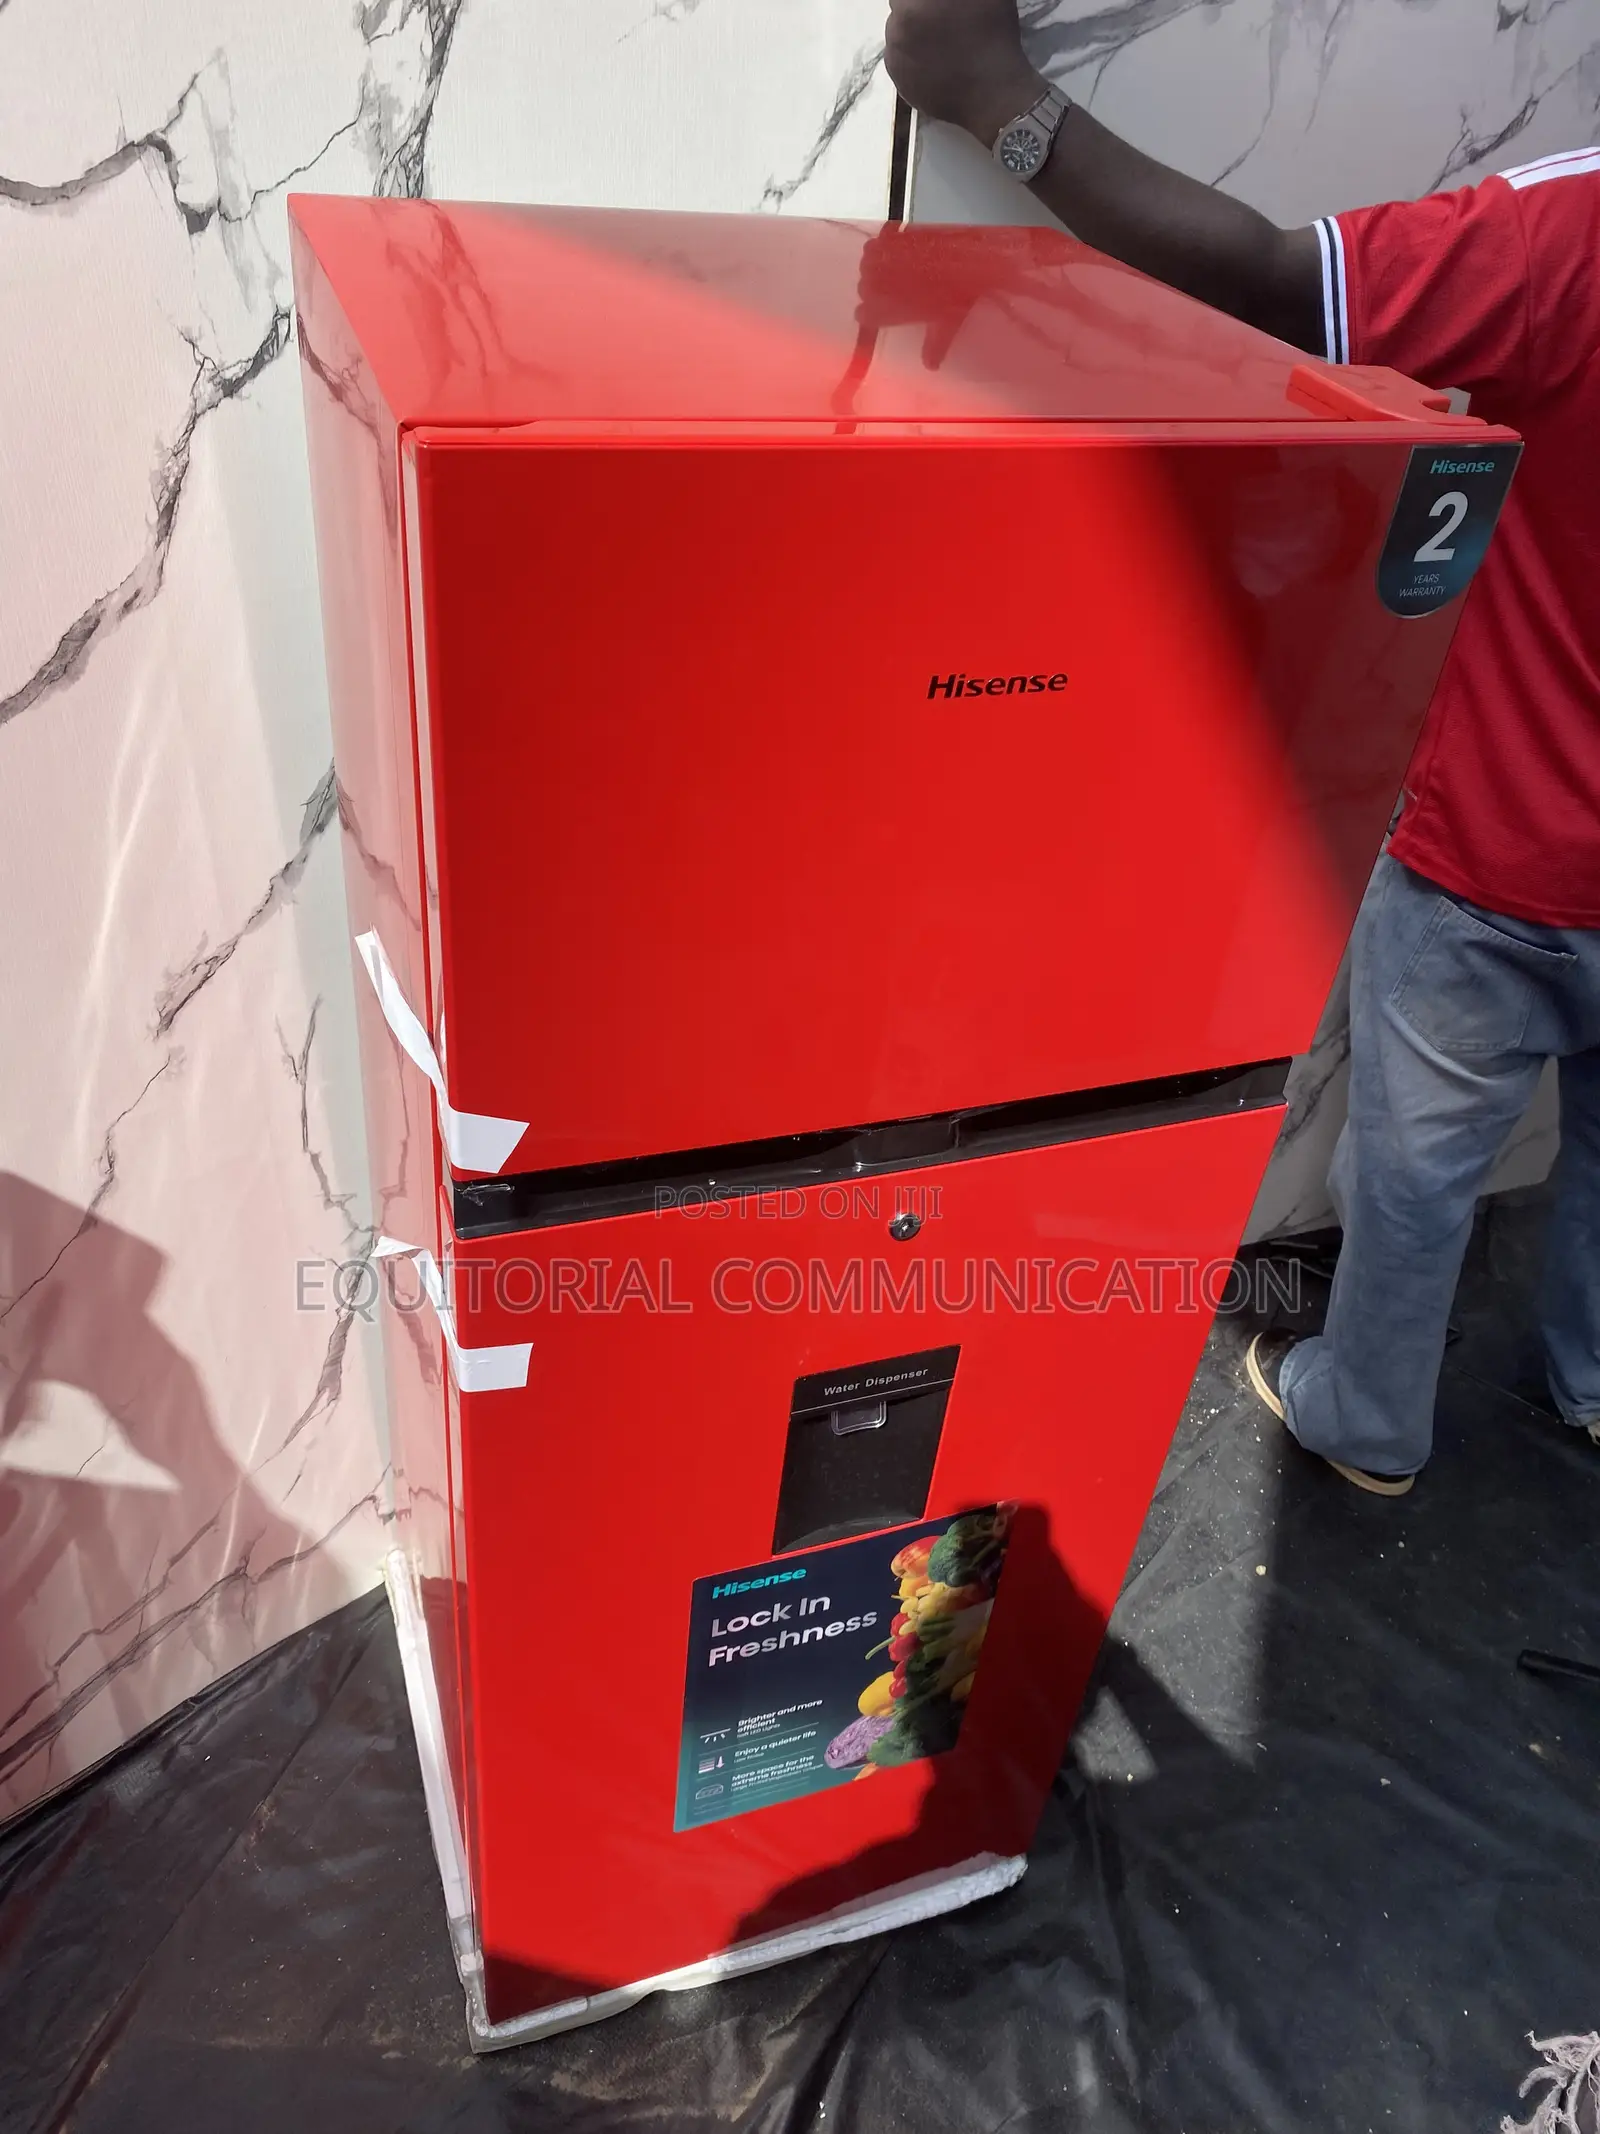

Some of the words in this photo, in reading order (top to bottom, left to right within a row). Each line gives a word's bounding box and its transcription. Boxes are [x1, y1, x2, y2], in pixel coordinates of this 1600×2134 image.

[1429, 459, 1495, 474] Hisense
[1413, 491, 1468, 562] 2
[1399, 586, 1446, 597] WARRANTY
[1413, 573, 1440, 584] YEARS
[927, 673, 1068, 700] Hisense
[824, 1382, 860, 1396] Water
[865, 1368, 929, 1388] Dispenser
[712, 1567, 807, 1599] Hisense
[711, 1602, 791, 1637] Lock
[799, 1595, 831, 1617] In
[708, 1611, 878, 1667] Freshness
[737, 1717, 776, 1733] efficient
[738, 1711, 777, 1727] Brighter
[777, 1705, 797, 1716] and
[797, 1699, 823, 1711] more
[734, 1746, 760, 1757] Enjoy
[768, 1735, 802, 1749] quieter
[802, 1730, 816, 1740] life
[731, 1770, 756, 1781] More
[756, 1763, 785, 1776] space
[785, 1759, 799, 1768] for
[799, 1755, 815, 1764] the
[731, 1773, 770, 1787] extreme
[770, 1761, 813, 1777] freshness
